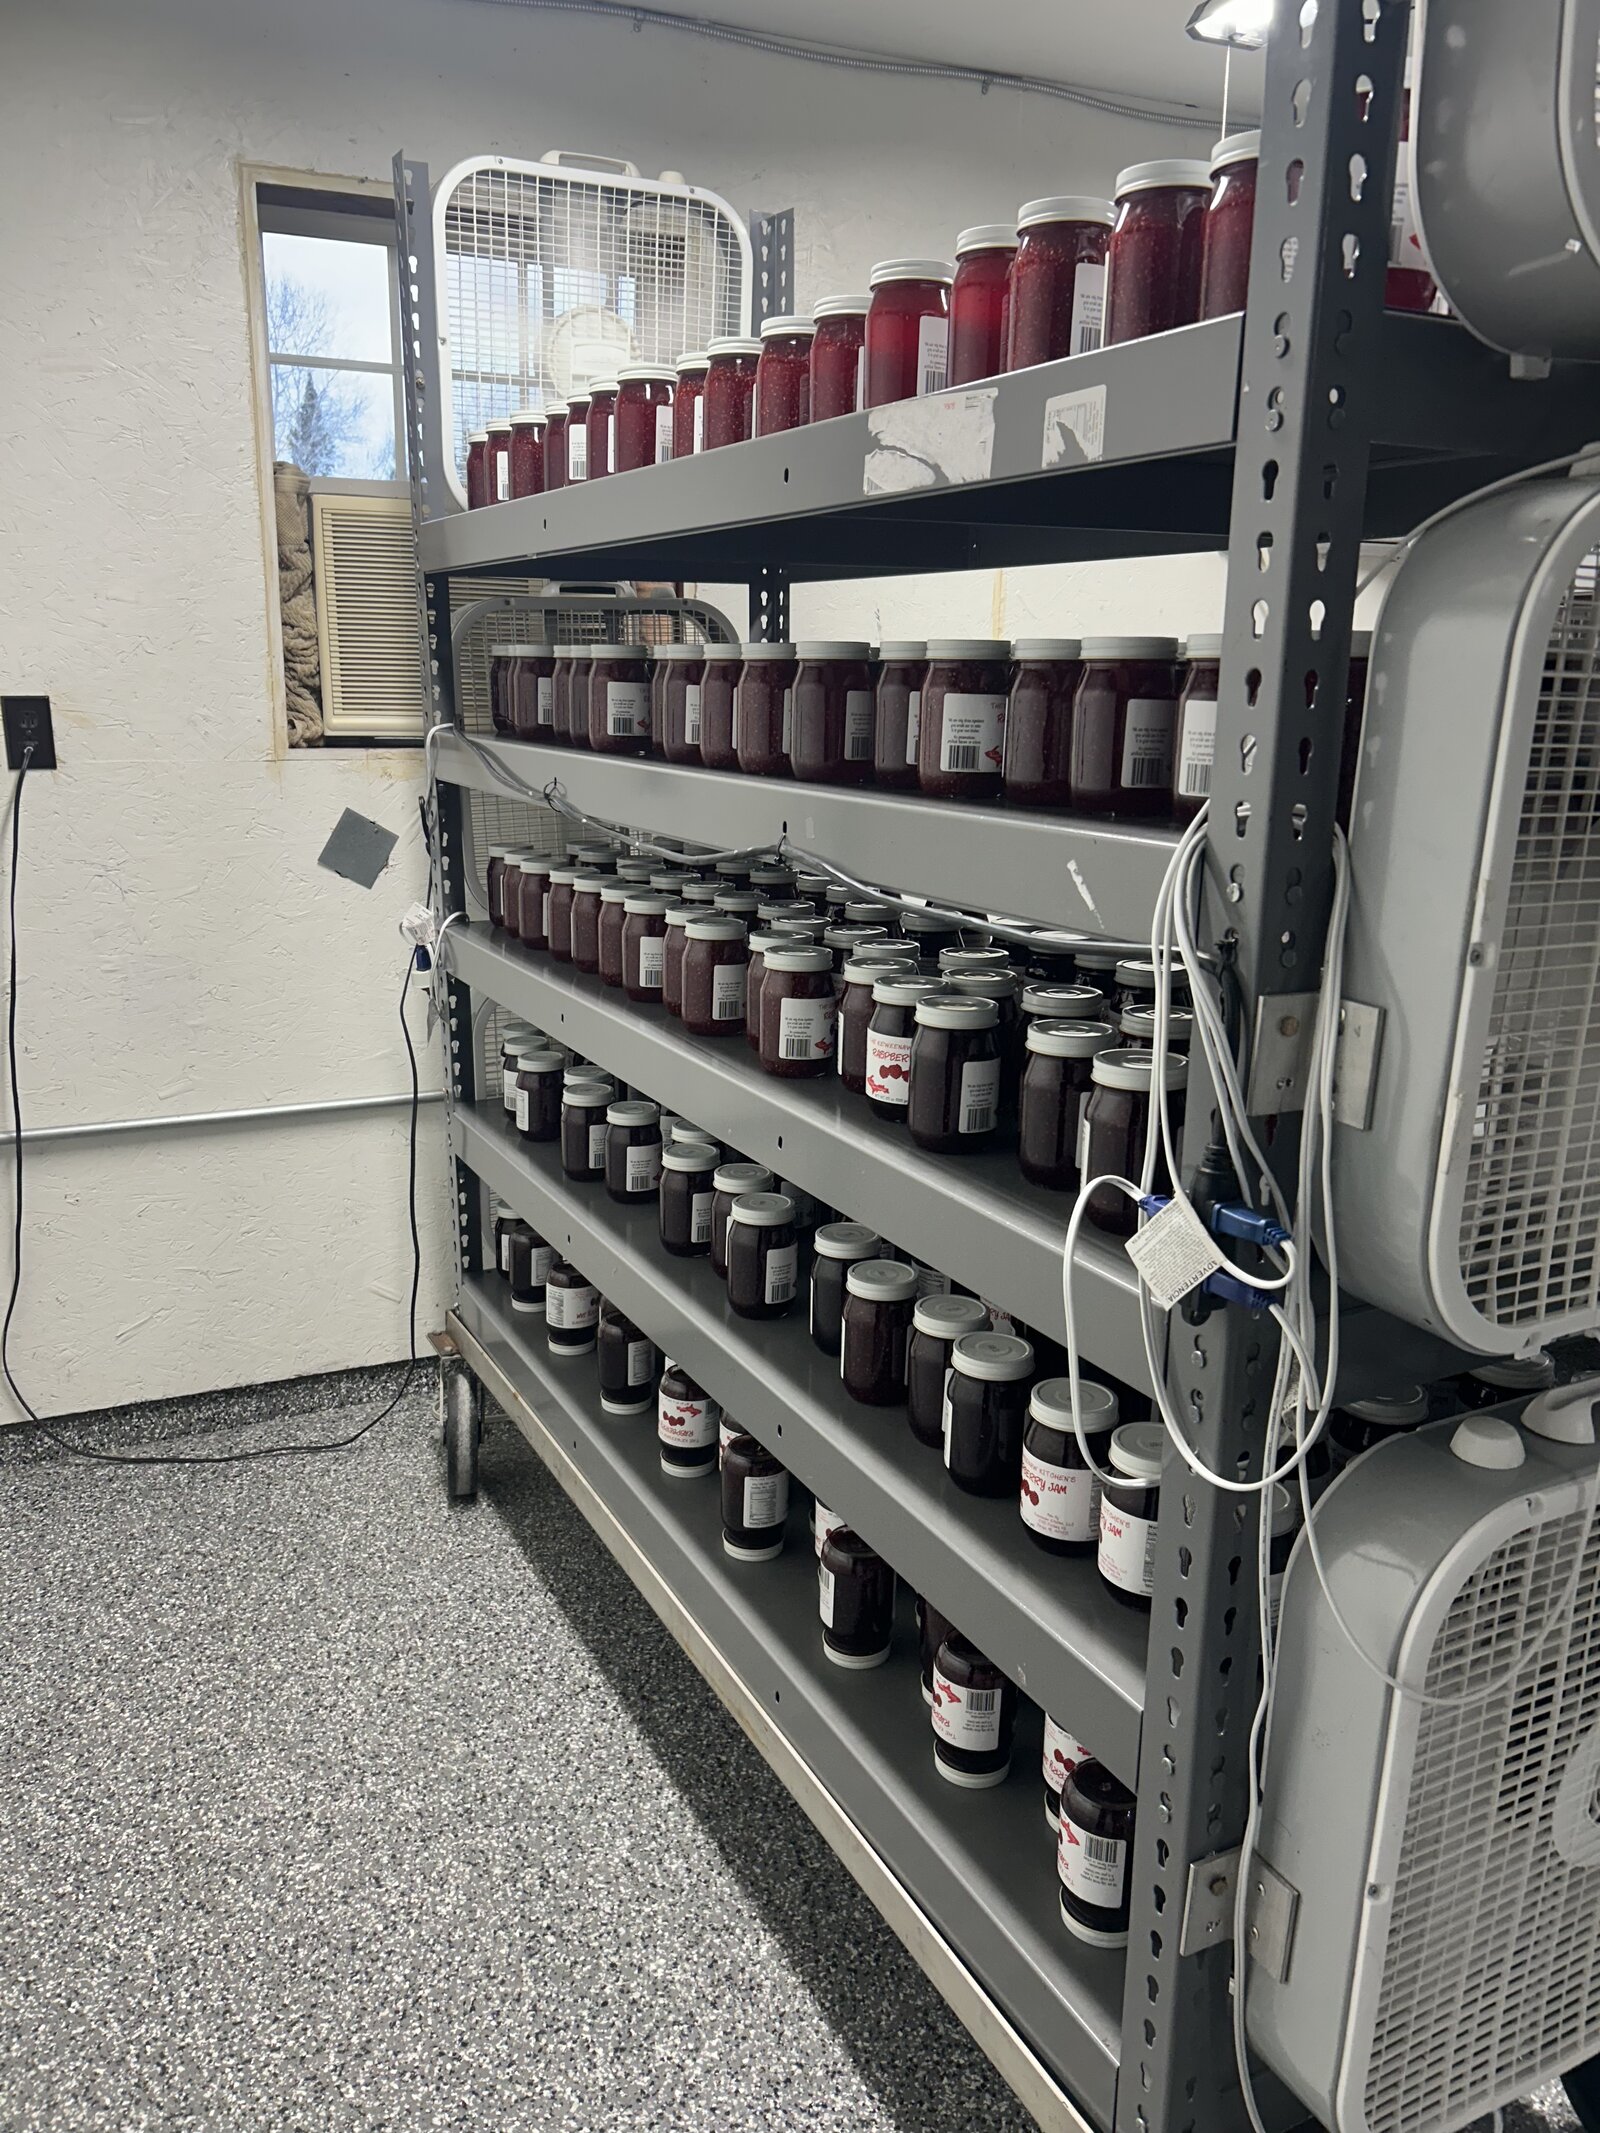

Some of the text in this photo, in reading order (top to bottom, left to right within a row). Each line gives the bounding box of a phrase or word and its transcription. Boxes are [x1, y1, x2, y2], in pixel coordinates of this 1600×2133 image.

[872, 1047, 910, 1063] RASPBER
[1167, 1259, 1218, 1303] ADVERTENCIA
[1022, 1466, 1068, 1495] BERRY JAM
[1107, 1522, 1122, 1539] JAM
